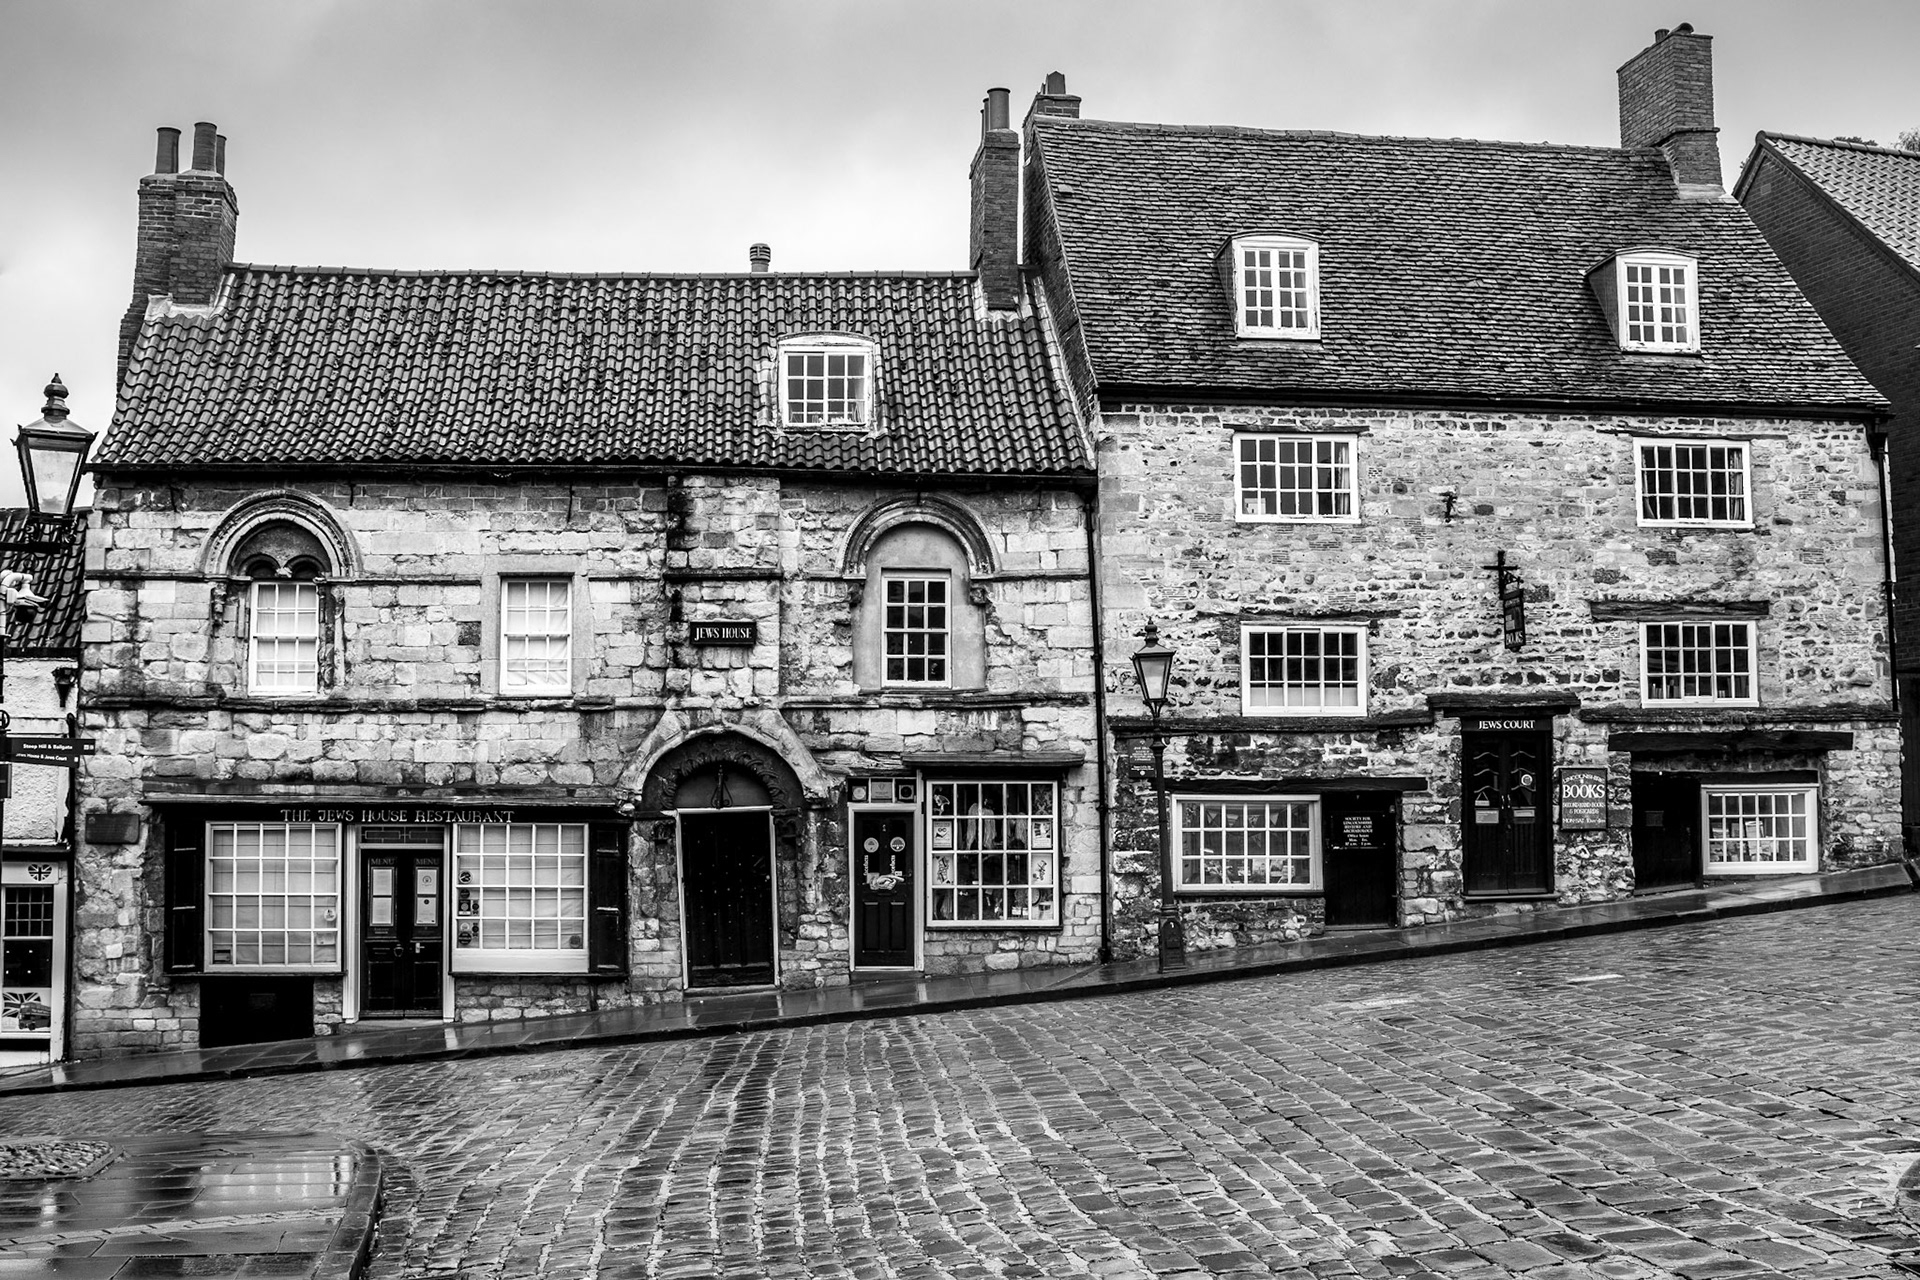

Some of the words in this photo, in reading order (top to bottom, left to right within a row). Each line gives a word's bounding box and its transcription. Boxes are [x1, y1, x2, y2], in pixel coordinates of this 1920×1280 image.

[694, 627, 720, 641] JEWS
[722, 627, 752, 639] HOUSE
[1479, 720, 1502, 729] JEWS
[1503, 720, 1536, 729] COURT
[1562, 774, 1606, 784] LINCOLNSHIRE
[1562, 784, 1606, 799] BOOKS
[280, 809, 311, 822] THE
[318, 809, 354, 822] JEWS
[361, 809, 408, 822] HOUSE
[414, 810, 515, 823] RESTAURANT
[371, 858, 395, 866] MENU
[416, 857, 440, 865] MENU
